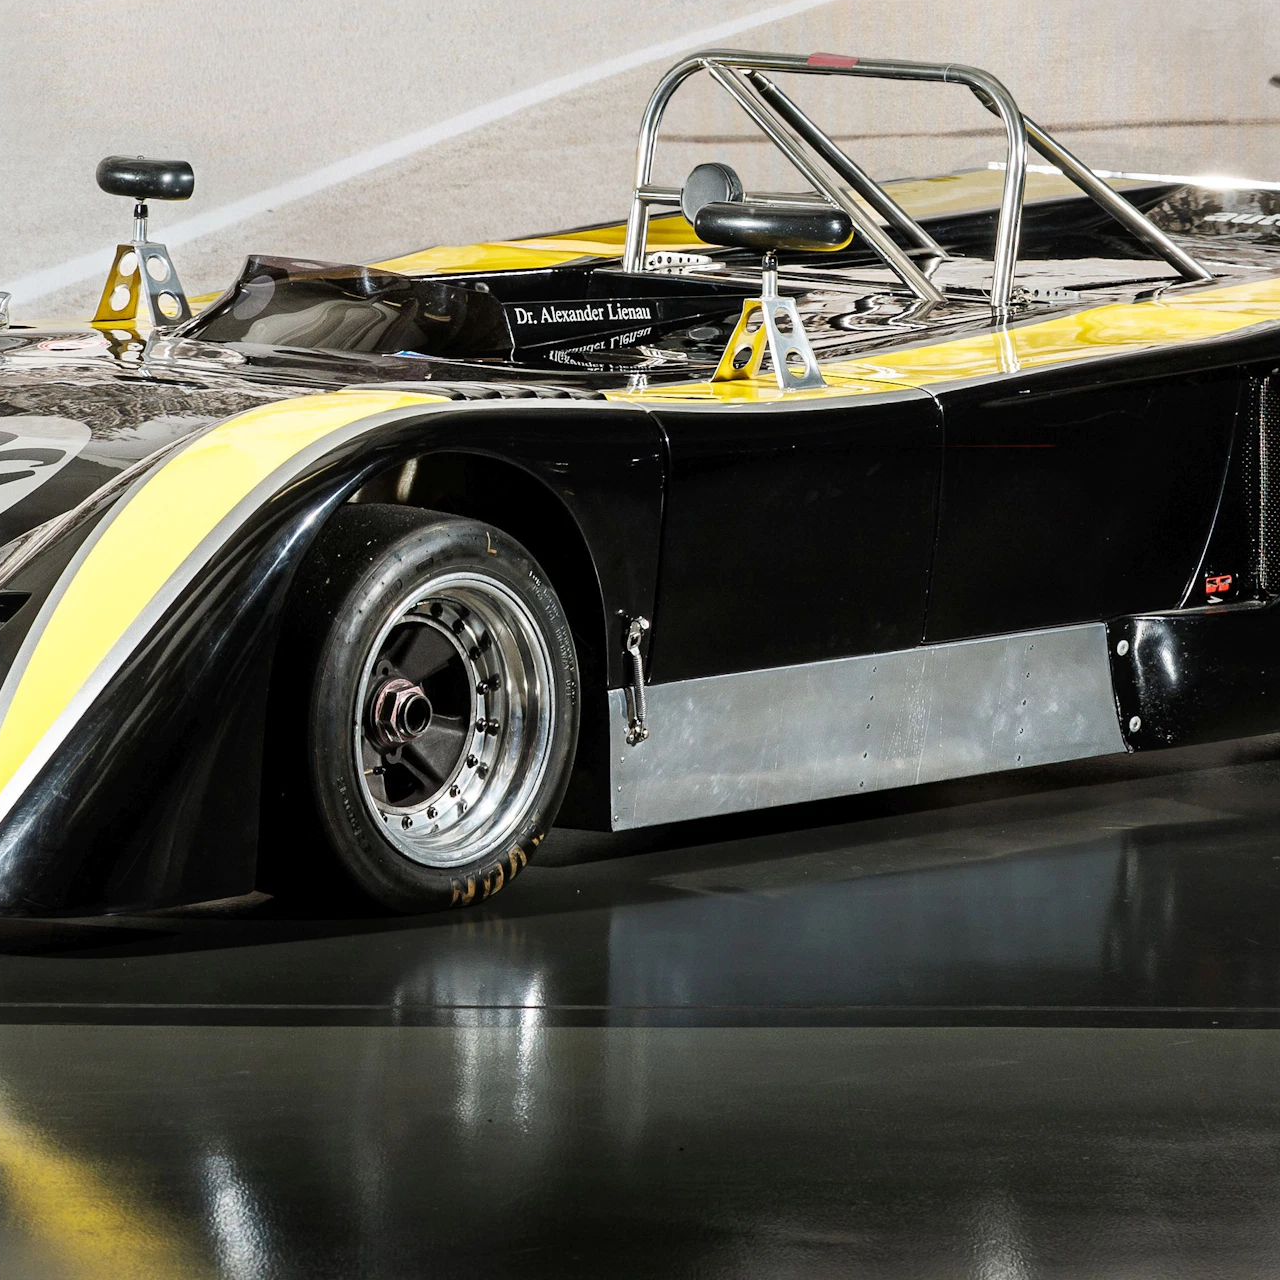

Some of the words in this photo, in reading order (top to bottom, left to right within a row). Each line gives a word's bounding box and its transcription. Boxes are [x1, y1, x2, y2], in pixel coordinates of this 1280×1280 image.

[514, 307, 538, 325] Dr.
[540, 304, 604, 324] Alexander
[606, 303, 652, 320] Lienau
